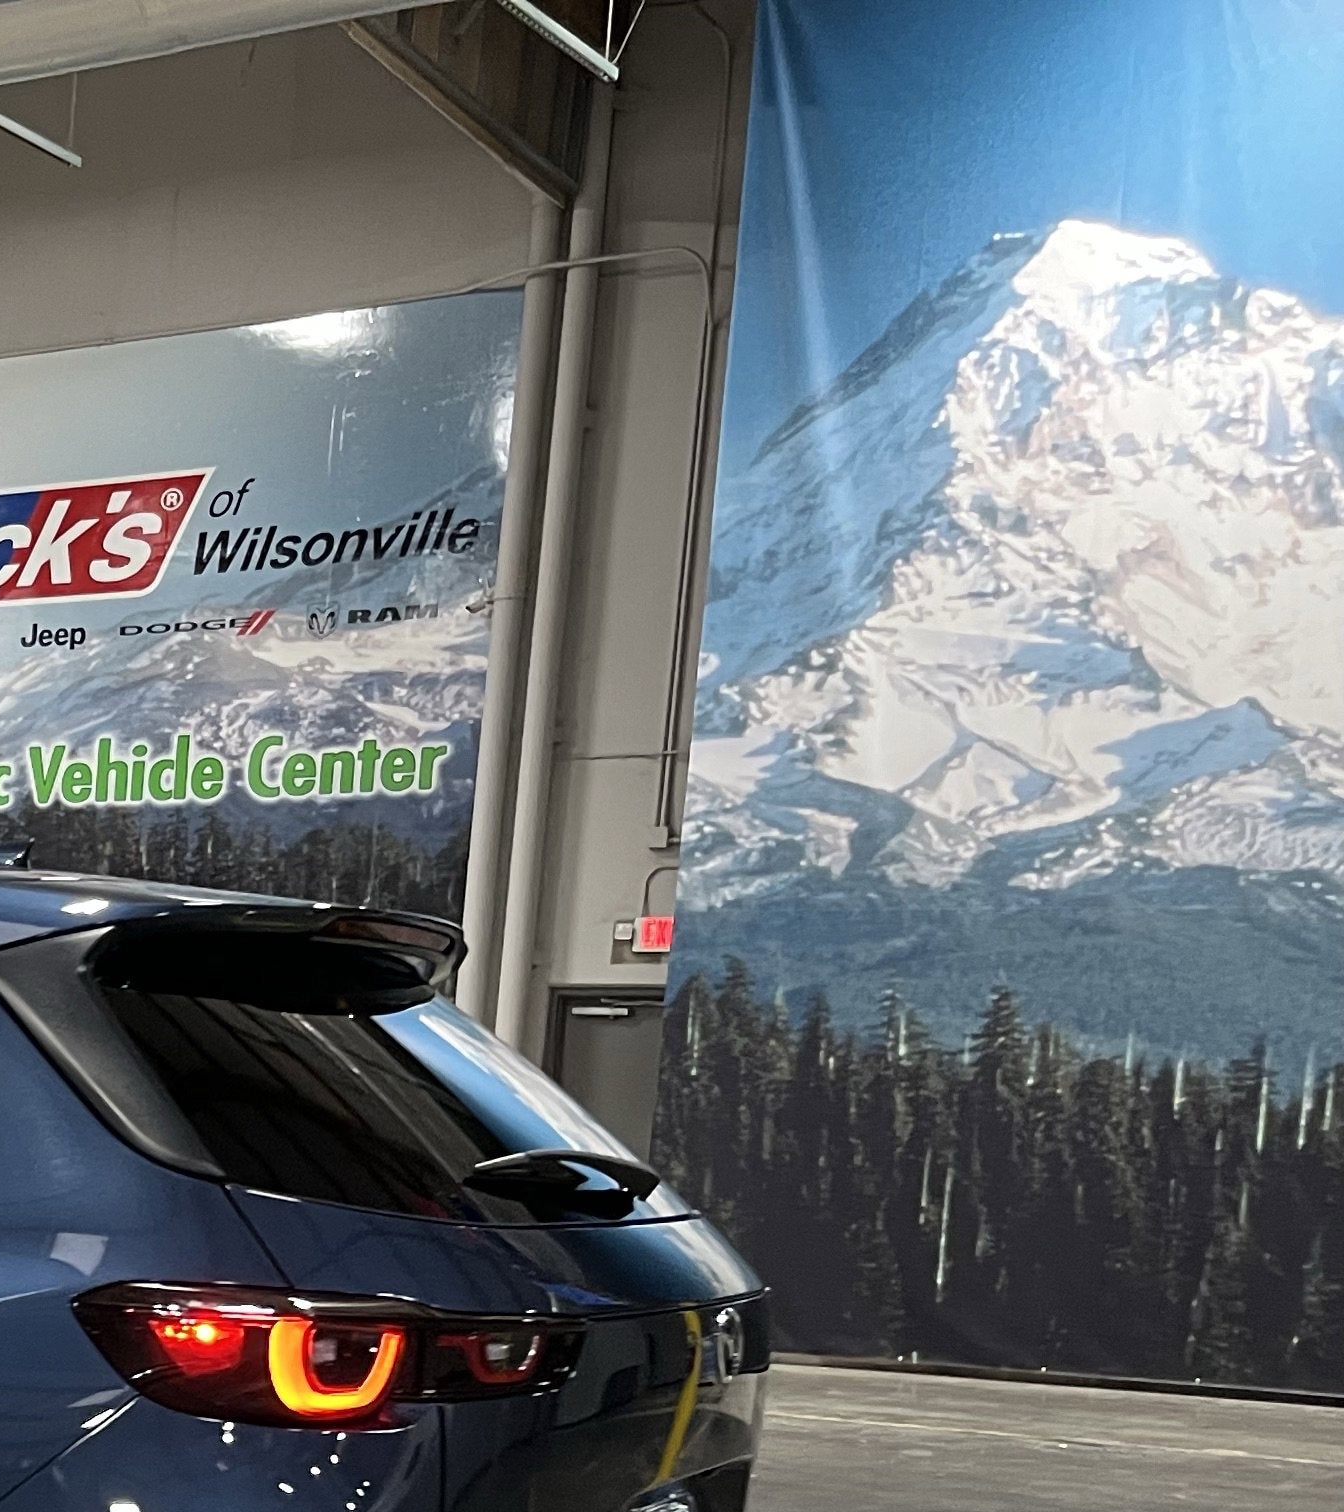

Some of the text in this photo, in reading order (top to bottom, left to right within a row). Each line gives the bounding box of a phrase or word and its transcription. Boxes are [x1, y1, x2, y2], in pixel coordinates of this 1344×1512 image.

[208, 478, 256, 518] of
[193, 507, 481, 576] Wilsonville
[119, 617, 254, 636] DODGE
[347, 604, 439, 624] RAM
[20, 623, 87, 650] Jeep
[28, 735, 224, 804] Vehicle
[248, 736, 447, 798] Center
[643, 919, 673, 945] EX
